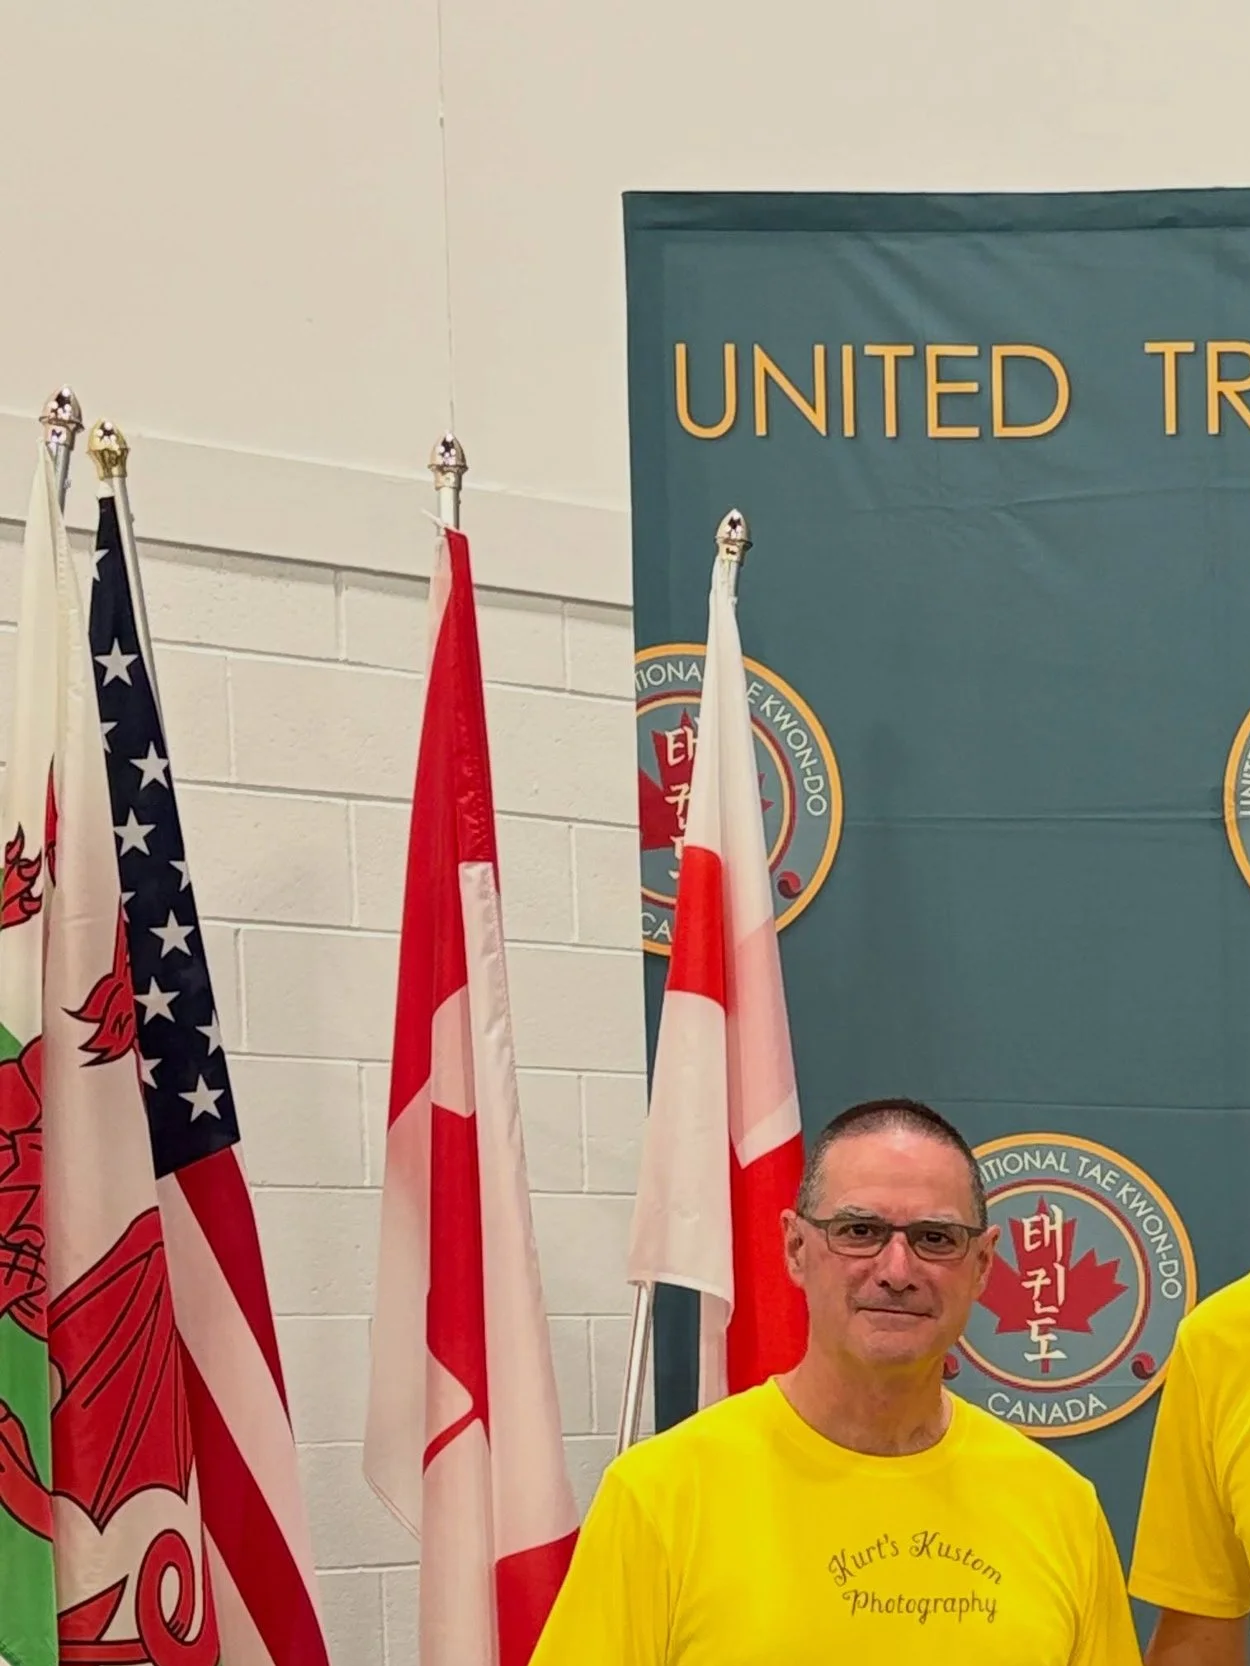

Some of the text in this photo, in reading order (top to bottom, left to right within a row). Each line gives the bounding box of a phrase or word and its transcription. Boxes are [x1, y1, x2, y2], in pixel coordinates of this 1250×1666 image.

[674, 341, 1071, 439] UNITED
[759, 694, 828, 817] KWON-DO
[980, 1150, 1182, 1299] ITIONAL TAE KWON-DO
[987, 1392, 1107, 1425] CANADA
[828, 1530, 1002, 1587] Kurt's Kustom
[842, 1589, 998, 1625] Photography
